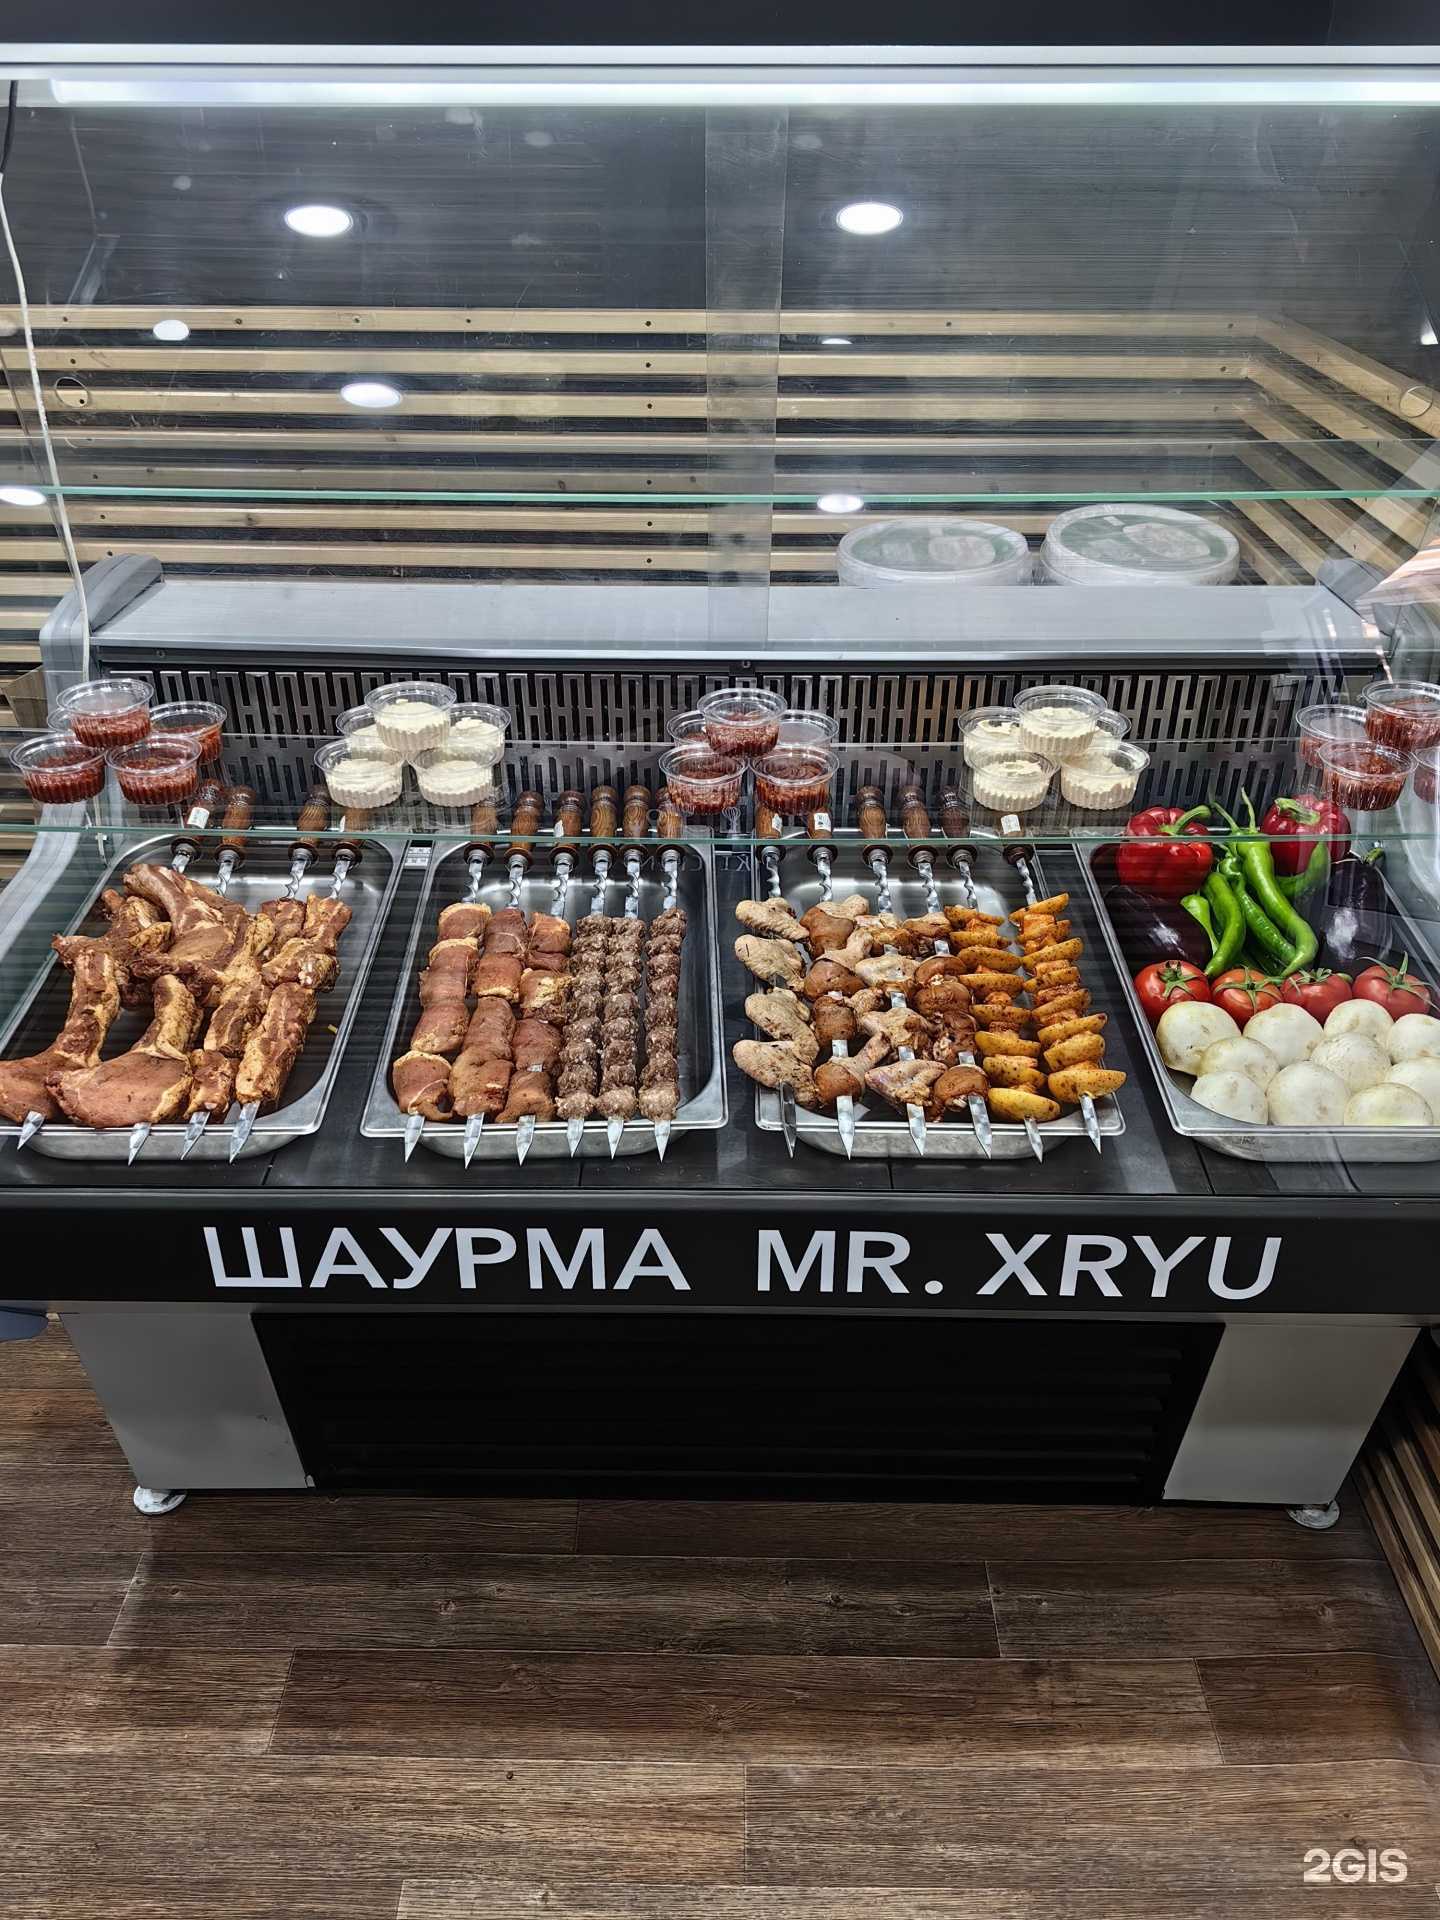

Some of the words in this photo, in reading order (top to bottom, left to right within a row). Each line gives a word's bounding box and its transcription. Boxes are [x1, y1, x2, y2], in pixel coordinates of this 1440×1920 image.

[203, 1226, 691, 1290] ШАУРМА
[757, 1229, 943, 1295] MR.
[977, 1233, 1282, 1300] XRYU
